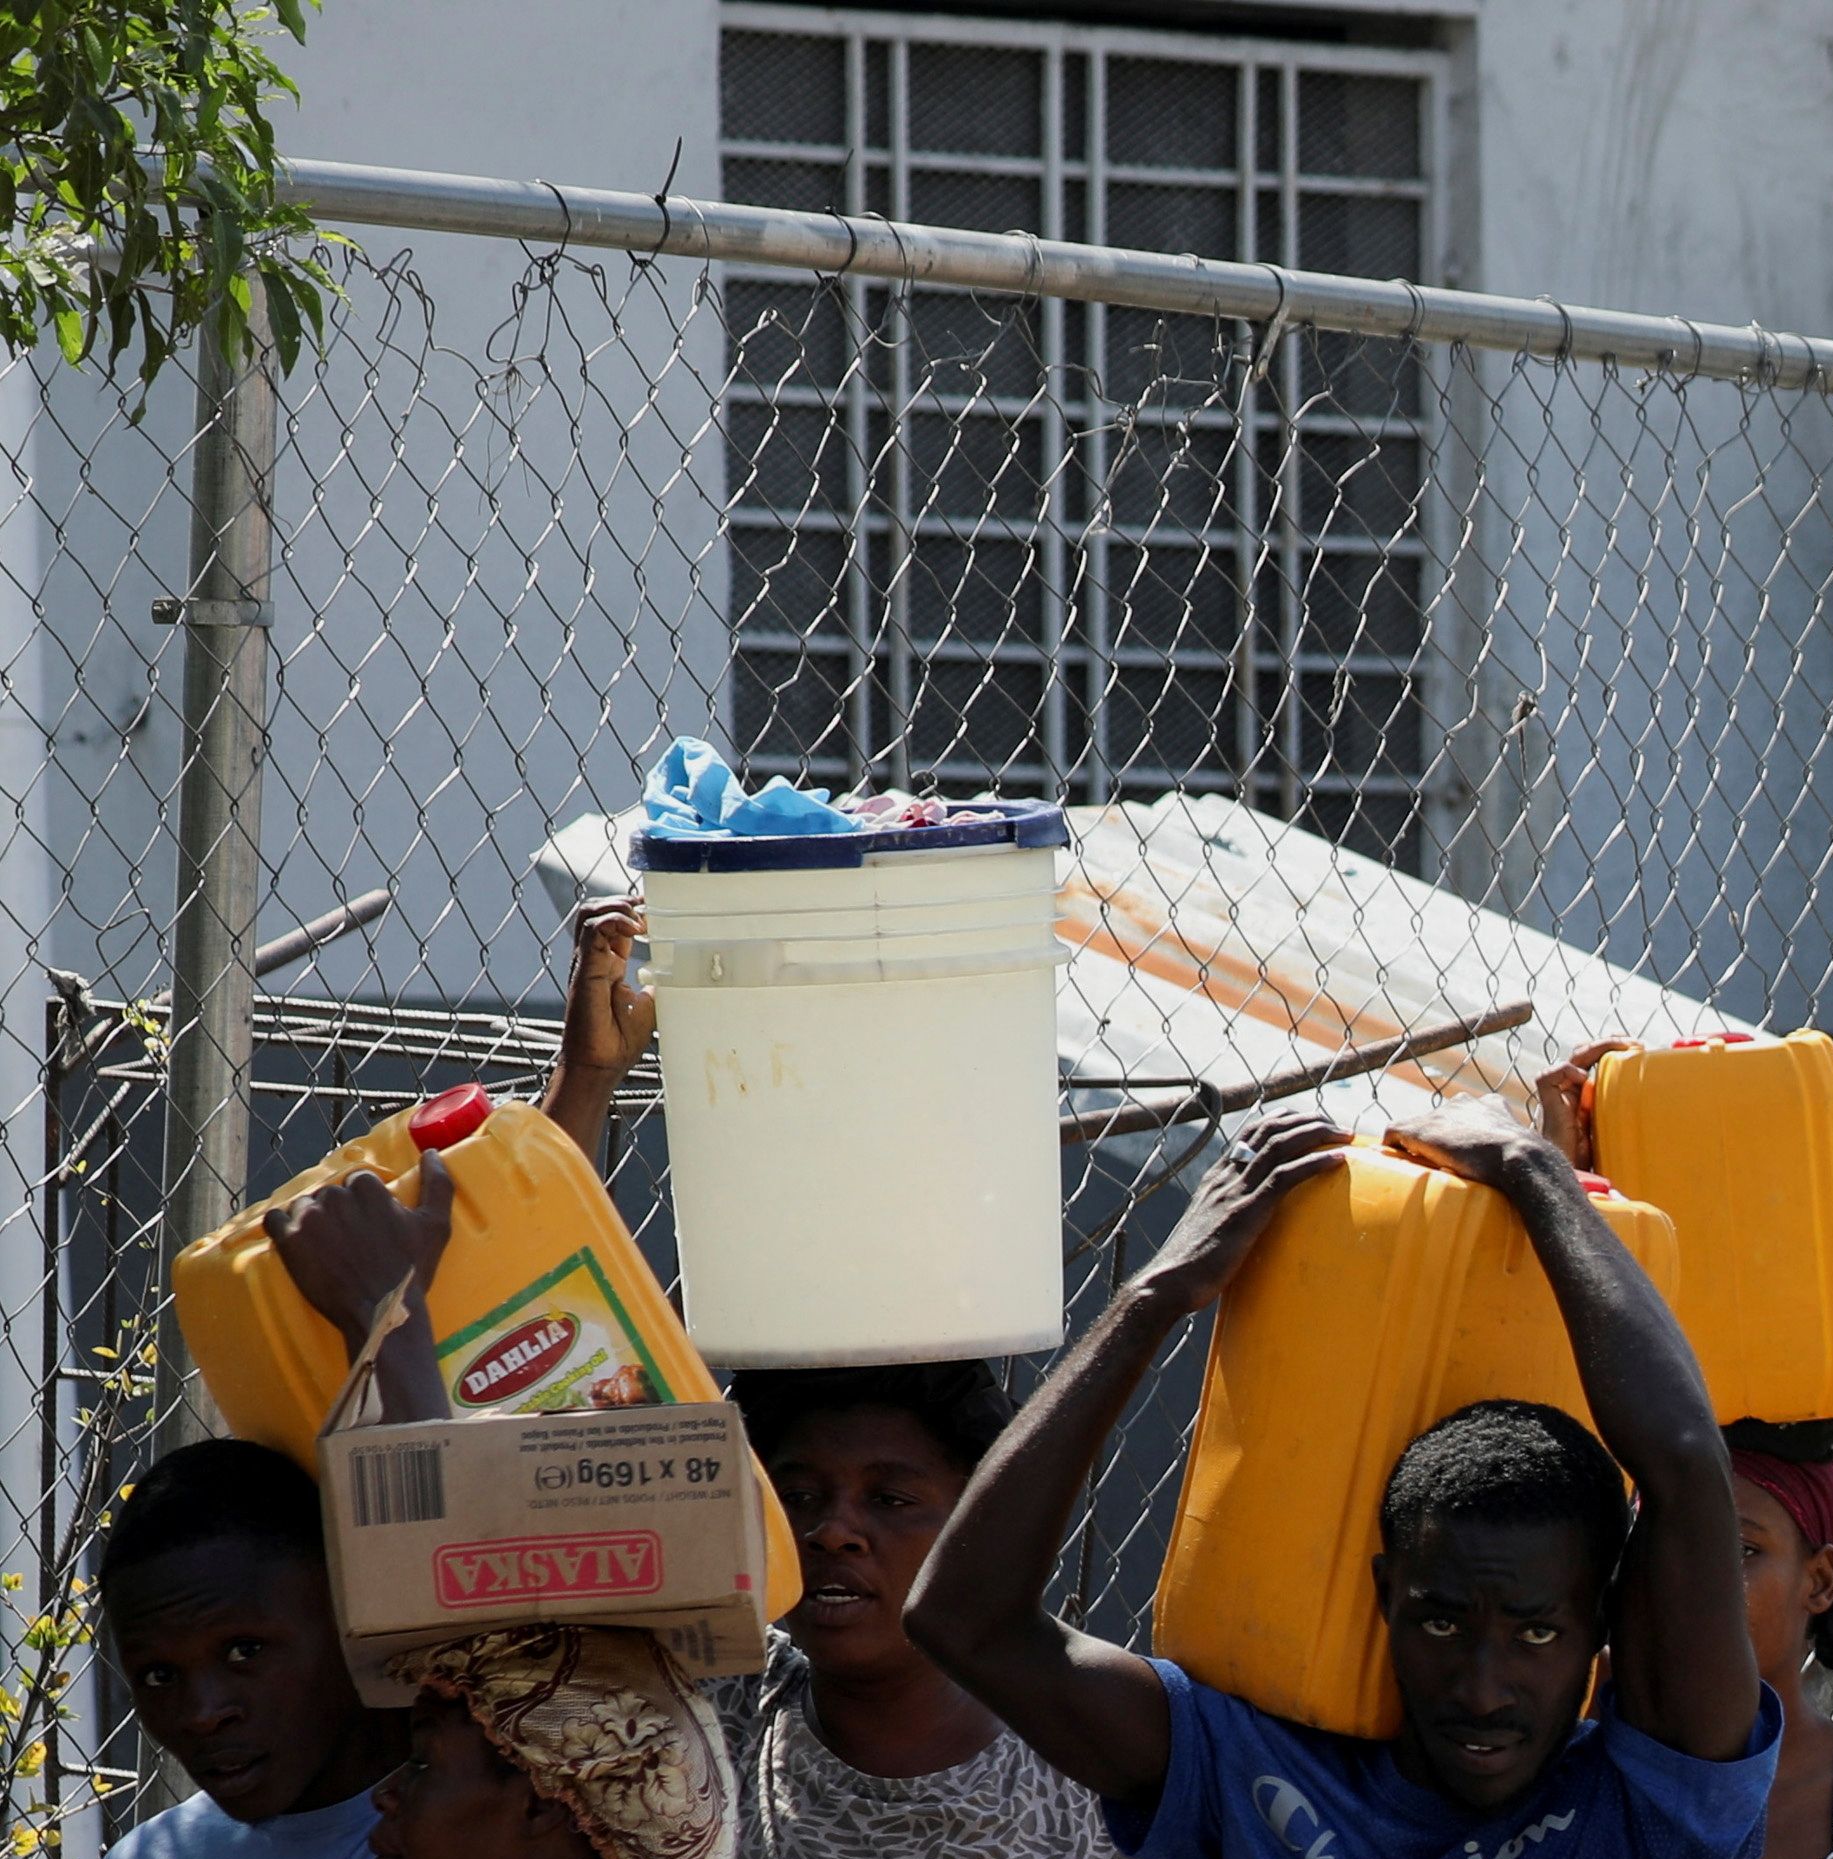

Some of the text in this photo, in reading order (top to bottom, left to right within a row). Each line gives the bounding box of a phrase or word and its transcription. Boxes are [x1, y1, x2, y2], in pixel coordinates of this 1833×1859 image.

[464, 1321, 569, 1395] DAHLIA
[659, 1459, 675, 1480] x
[686, 1457, 720, 1483] 48
[445, 1542, 650, 1595] ALASKA
